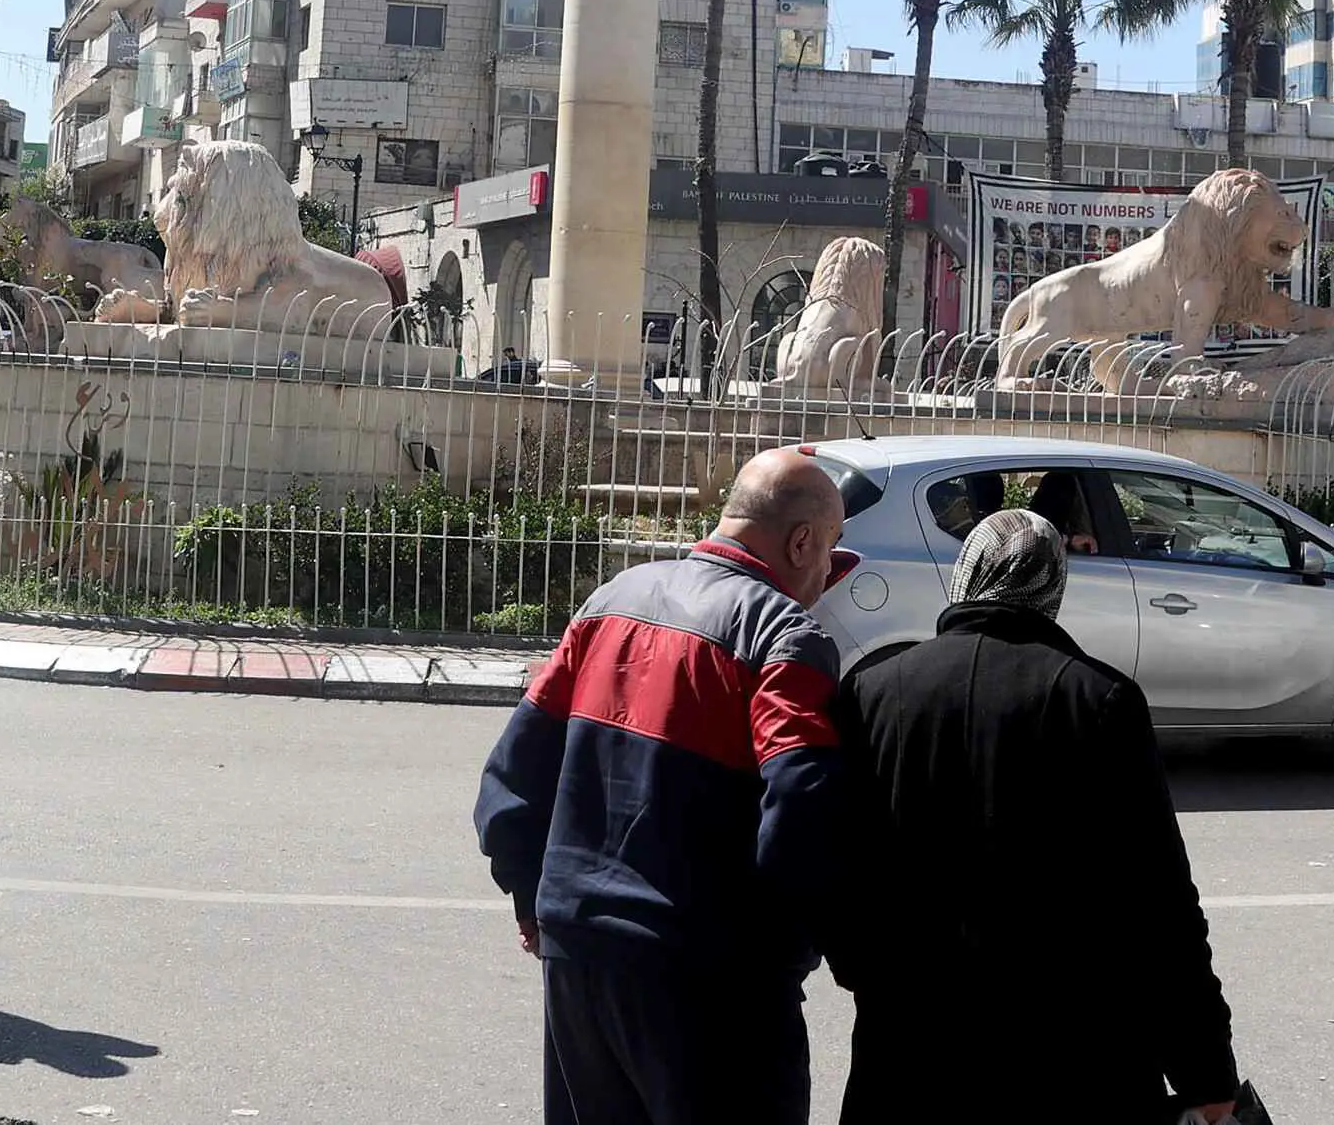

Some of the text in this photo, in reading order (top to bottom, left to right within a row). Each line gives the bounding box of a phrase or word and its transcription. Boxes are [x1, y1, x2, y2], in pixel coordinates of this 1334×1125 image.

[683, 189, 700, 199] BAN
[728, 191, 781, 204] PALESTINE
[990, 196, 1013, 212] WE
[1015, 199, 1044, 215] ARE
[1048, 201, 1078, 217] NOT
[1081, 203, 1155, 220] NUMBERS
